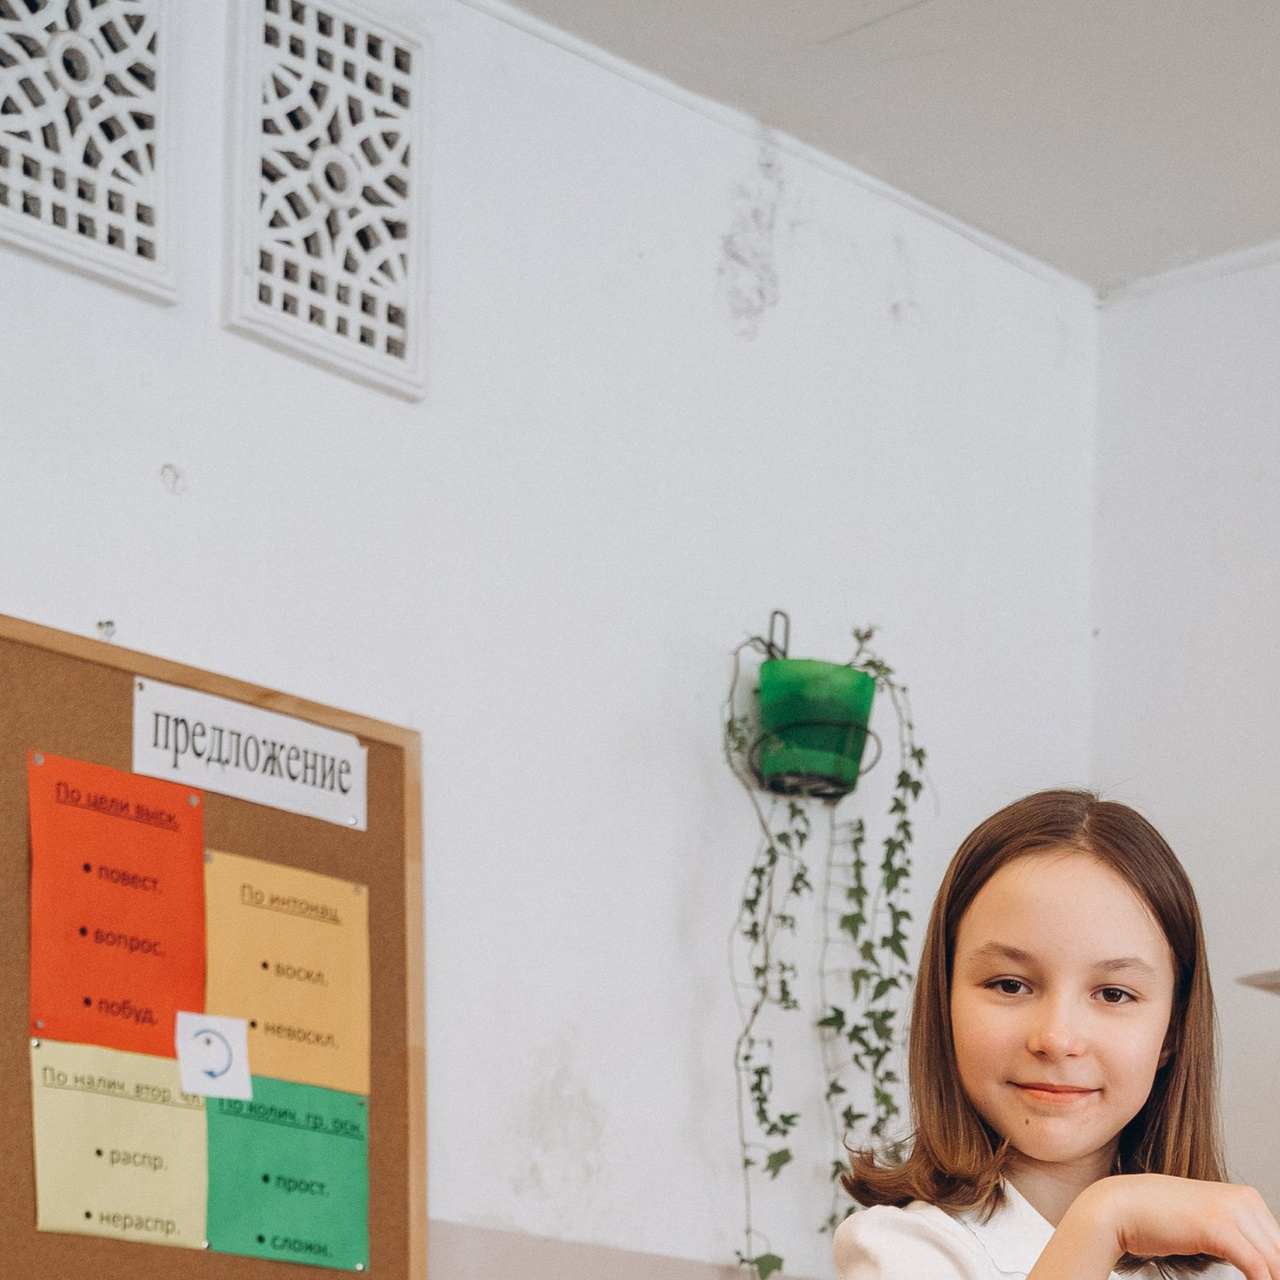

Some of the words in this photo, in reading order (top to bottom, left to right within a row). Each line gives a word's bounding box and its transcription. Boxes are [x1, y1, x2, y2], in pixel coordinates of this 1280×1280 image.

[152, 711, 353, 795] предложение
[55, 781, 82, 803] По
[86, 792, 130, 816] цели
[97, 864, 163, 894] повест.
[240, 883, 265, 905] По
[93, 927, 165, 957] вопрос.
[274, 962, 329, 987] воскл.
[264, 1021, 340, 1050] невоскл.
[42, 1065, 68, 1086] По
[109, 1149, 169, 1171] распр.
[275, 1174, 331, 1198] прост.
[99, 1211, 182, 1238] нераспр.
[270, 1234, 333, 1258] сложн.
